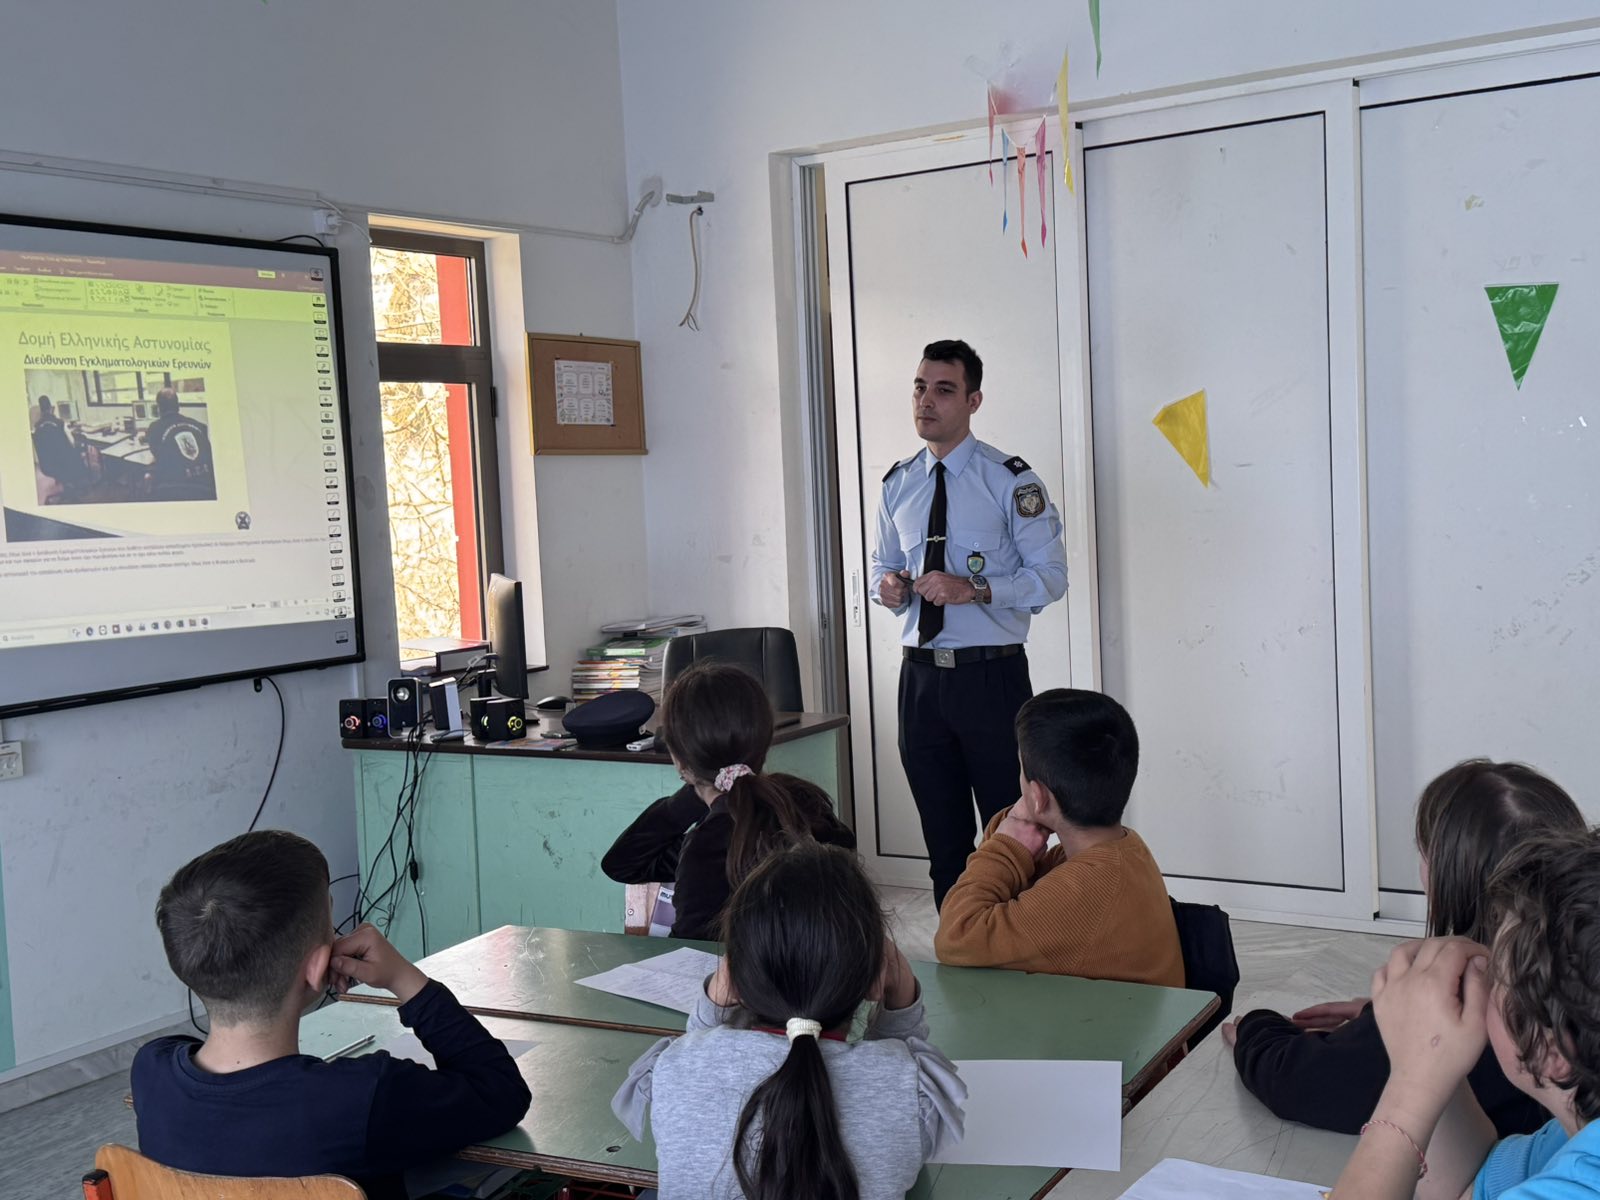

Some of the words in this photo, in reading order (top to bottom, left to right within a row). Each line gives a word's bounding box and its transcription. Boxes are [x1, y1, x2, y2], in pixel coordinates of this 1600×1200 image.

[18, 331, 55, 349] Δομή
[60, 333, 129, 351] Ελληνικής
[133, 336, 211, 354] Αστυνομίας
[24, 355, 77, 367] Διεύθυνση
[80, 356, 169, 369] Εγκληματολογικών
[172, 359, 211, 370] Ερευνών
